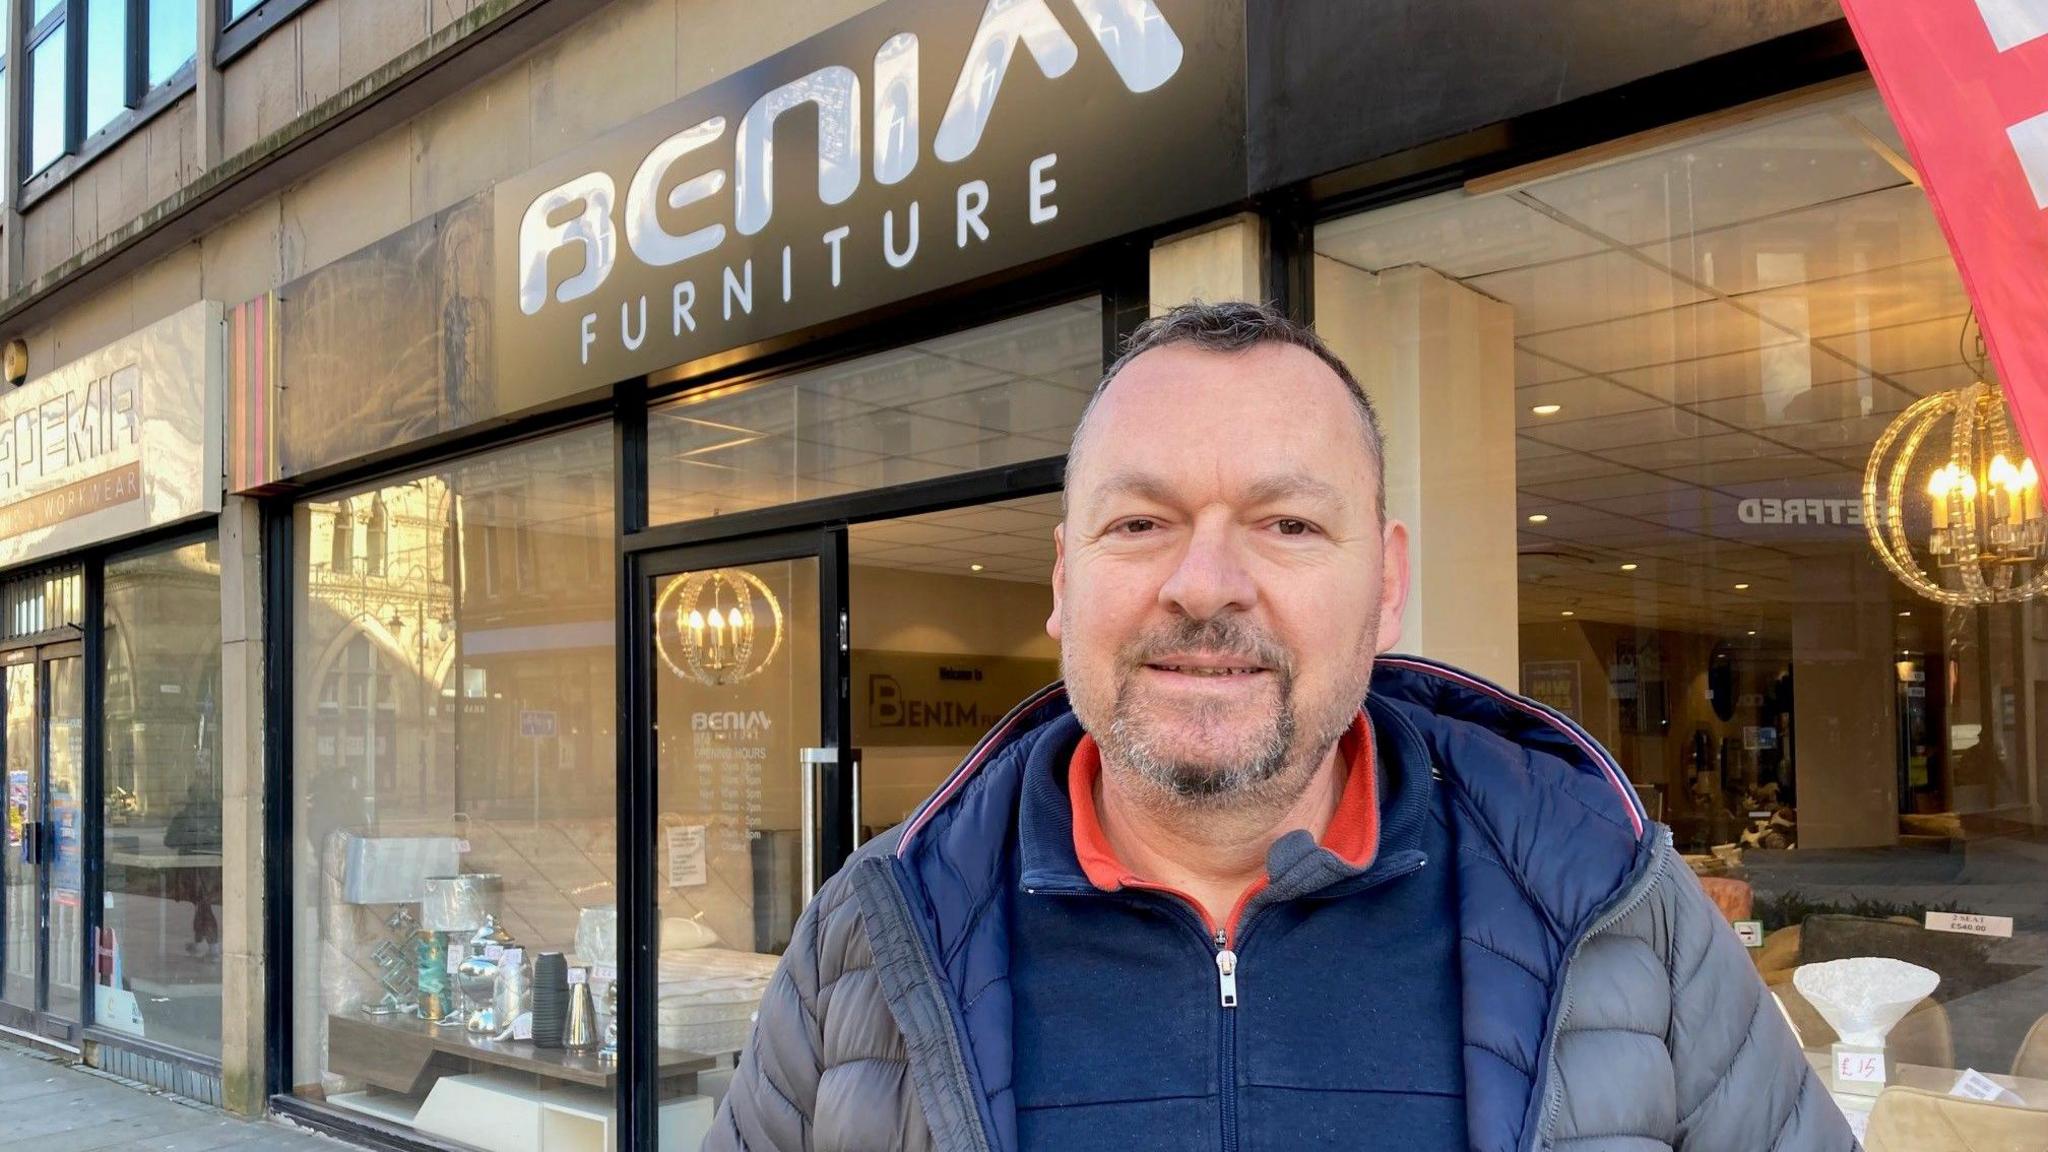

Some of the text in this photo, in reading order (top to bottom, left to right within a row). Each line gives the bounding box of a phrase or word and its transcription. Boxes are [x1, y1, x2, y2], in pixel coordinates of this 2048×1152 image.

[581, 152, 1058, 365] FURNITURE
[44, 471, 137, 519] WORKWEAR
[869, 673, 977, 728] BENIM
